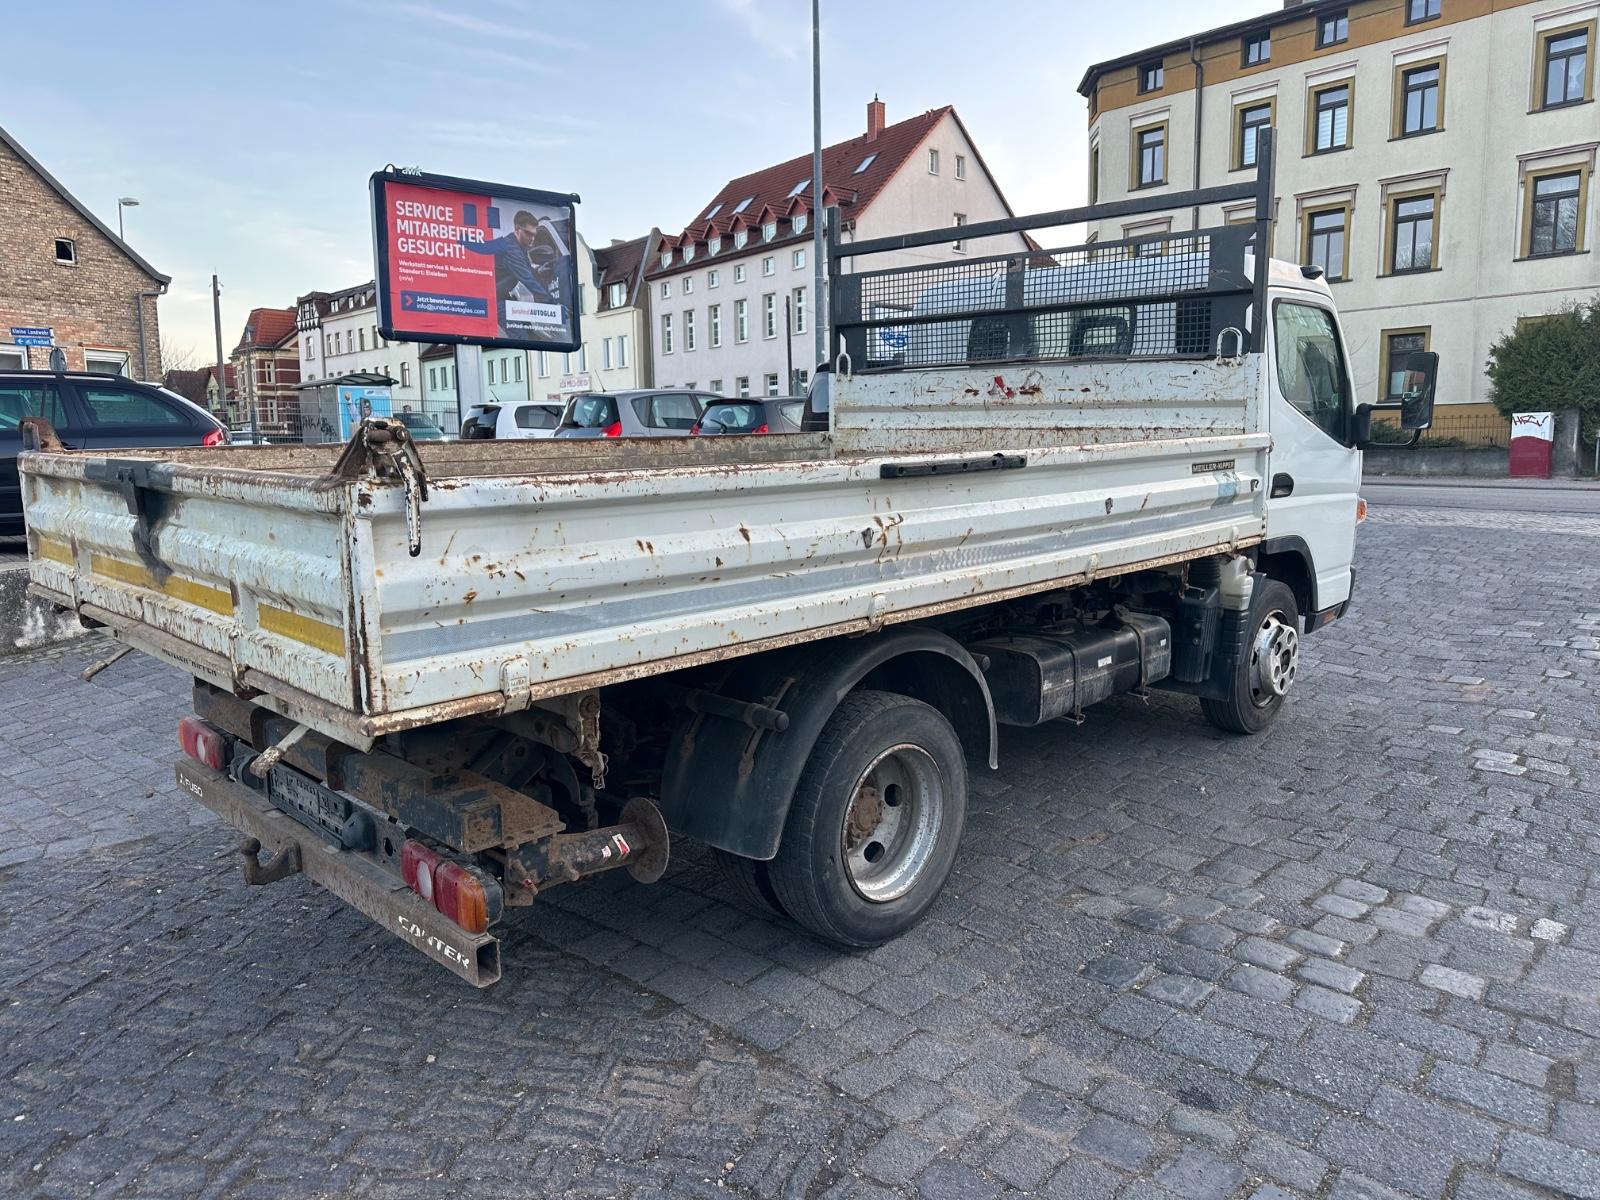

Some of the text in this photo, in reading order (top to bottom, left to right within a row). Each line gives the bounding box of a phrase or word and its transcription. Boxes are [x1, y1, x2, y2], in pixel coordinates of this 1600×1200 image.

[395, 200, 453, 221] SERVICE
[396, 218, 485, 244] MITARBEITER
[397, 237, 466, 260] GESUCHT!
[398, 266, 425, 276] Standort:
[416, 295, 430, 304] Jetzt
[429, 297, 452, 306] bewerben
[398, 915, 470, 969] CANTER
